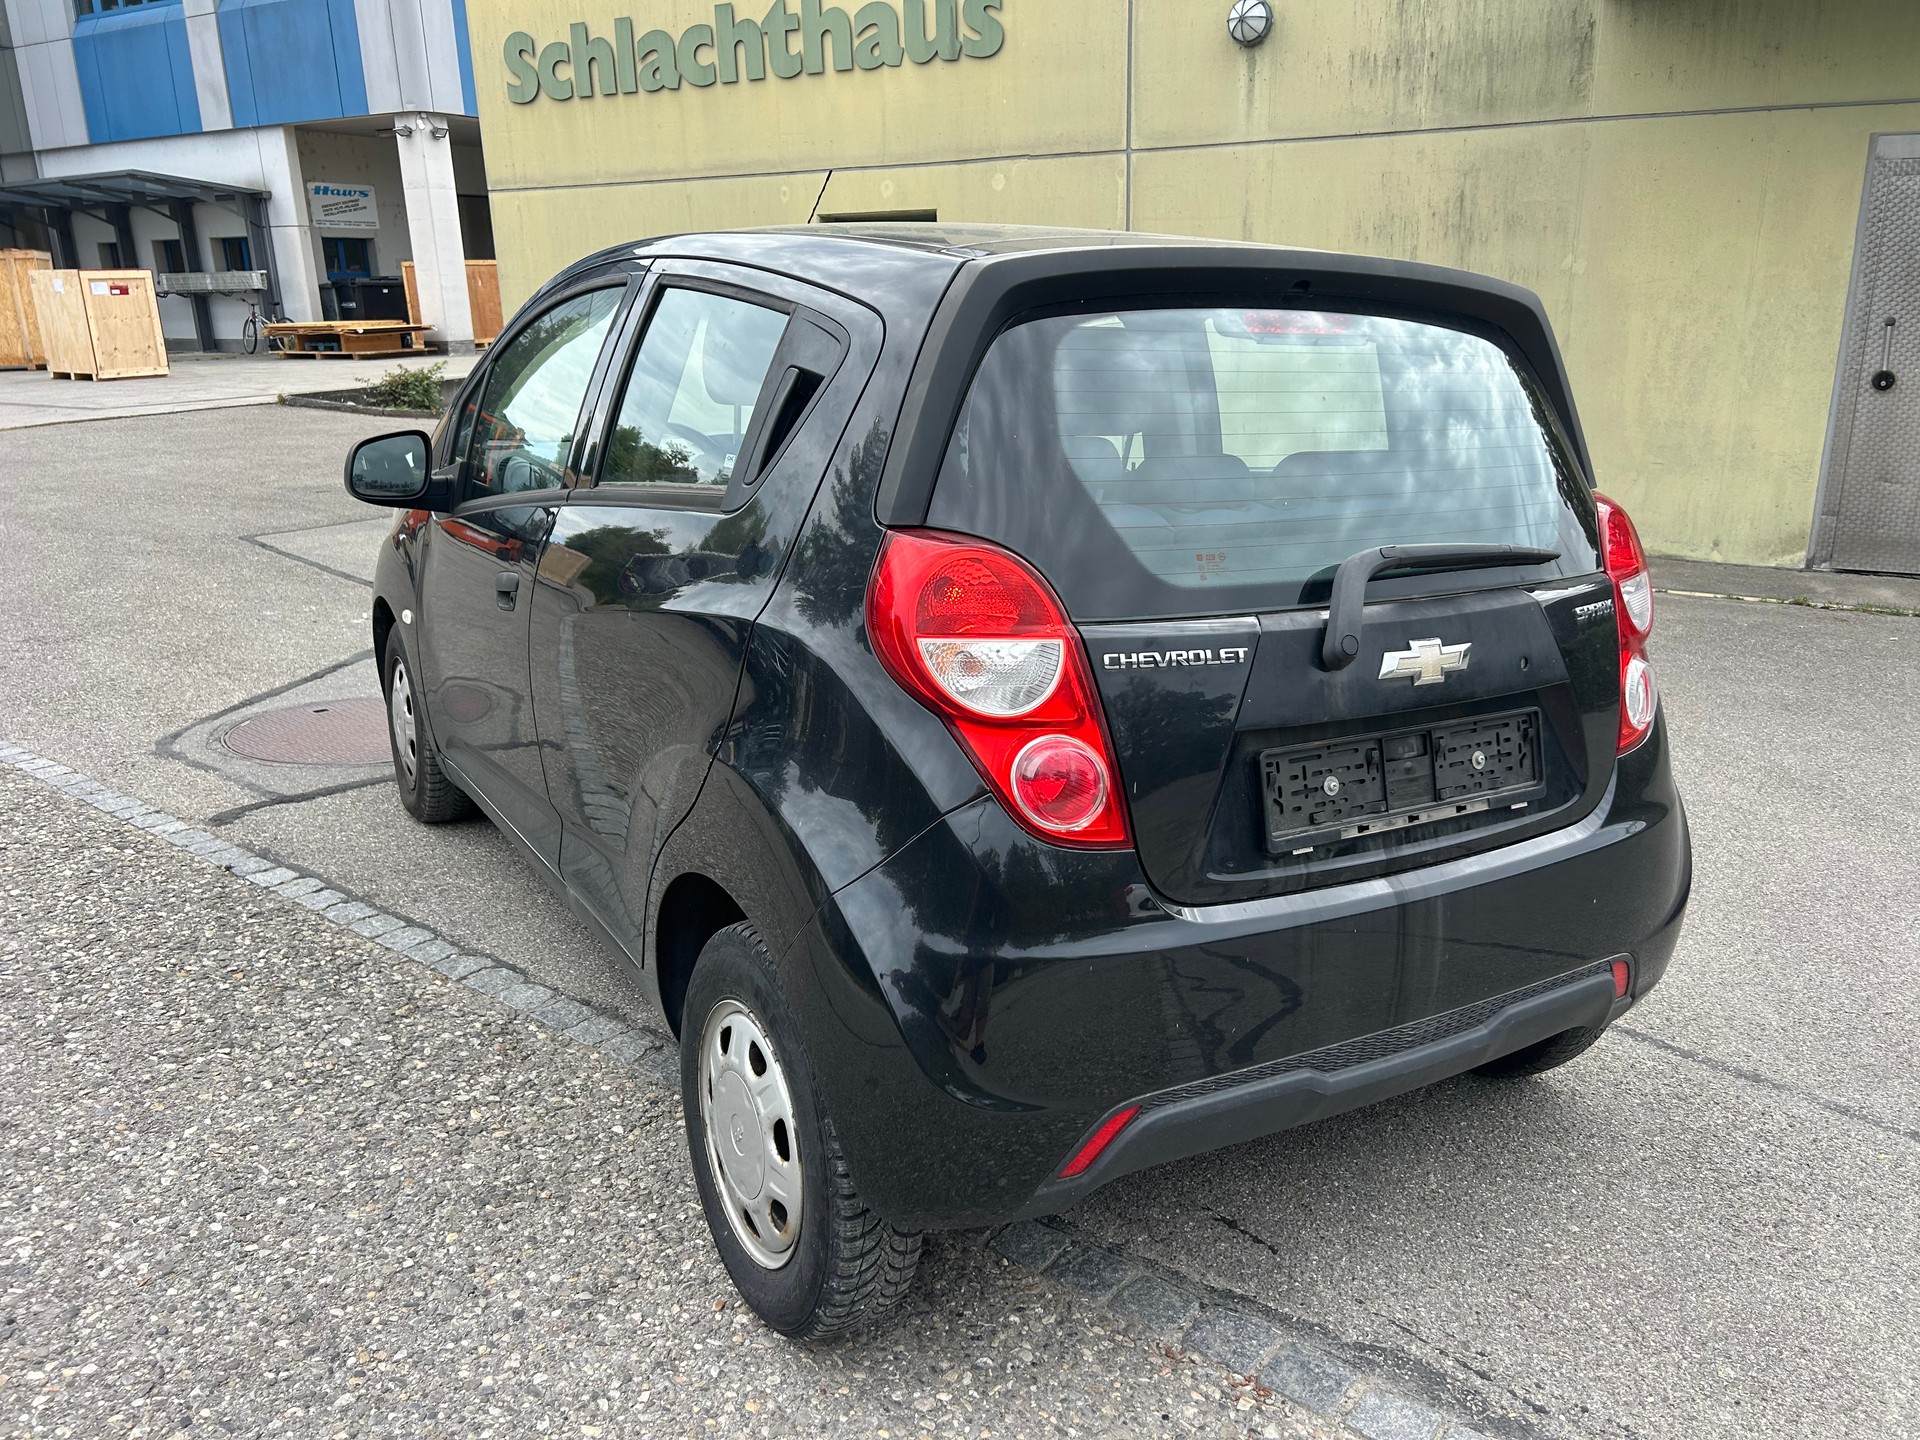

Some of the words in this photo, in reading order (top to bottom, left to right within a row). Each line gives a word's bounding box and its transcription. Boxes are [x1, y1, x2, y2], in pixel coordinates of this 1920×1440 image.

[502, 0, 1004, 104] Schlachthaus
[311, 185, 370, 198] Haws
[1103, 647, 1249, 670] CHEVROLET
